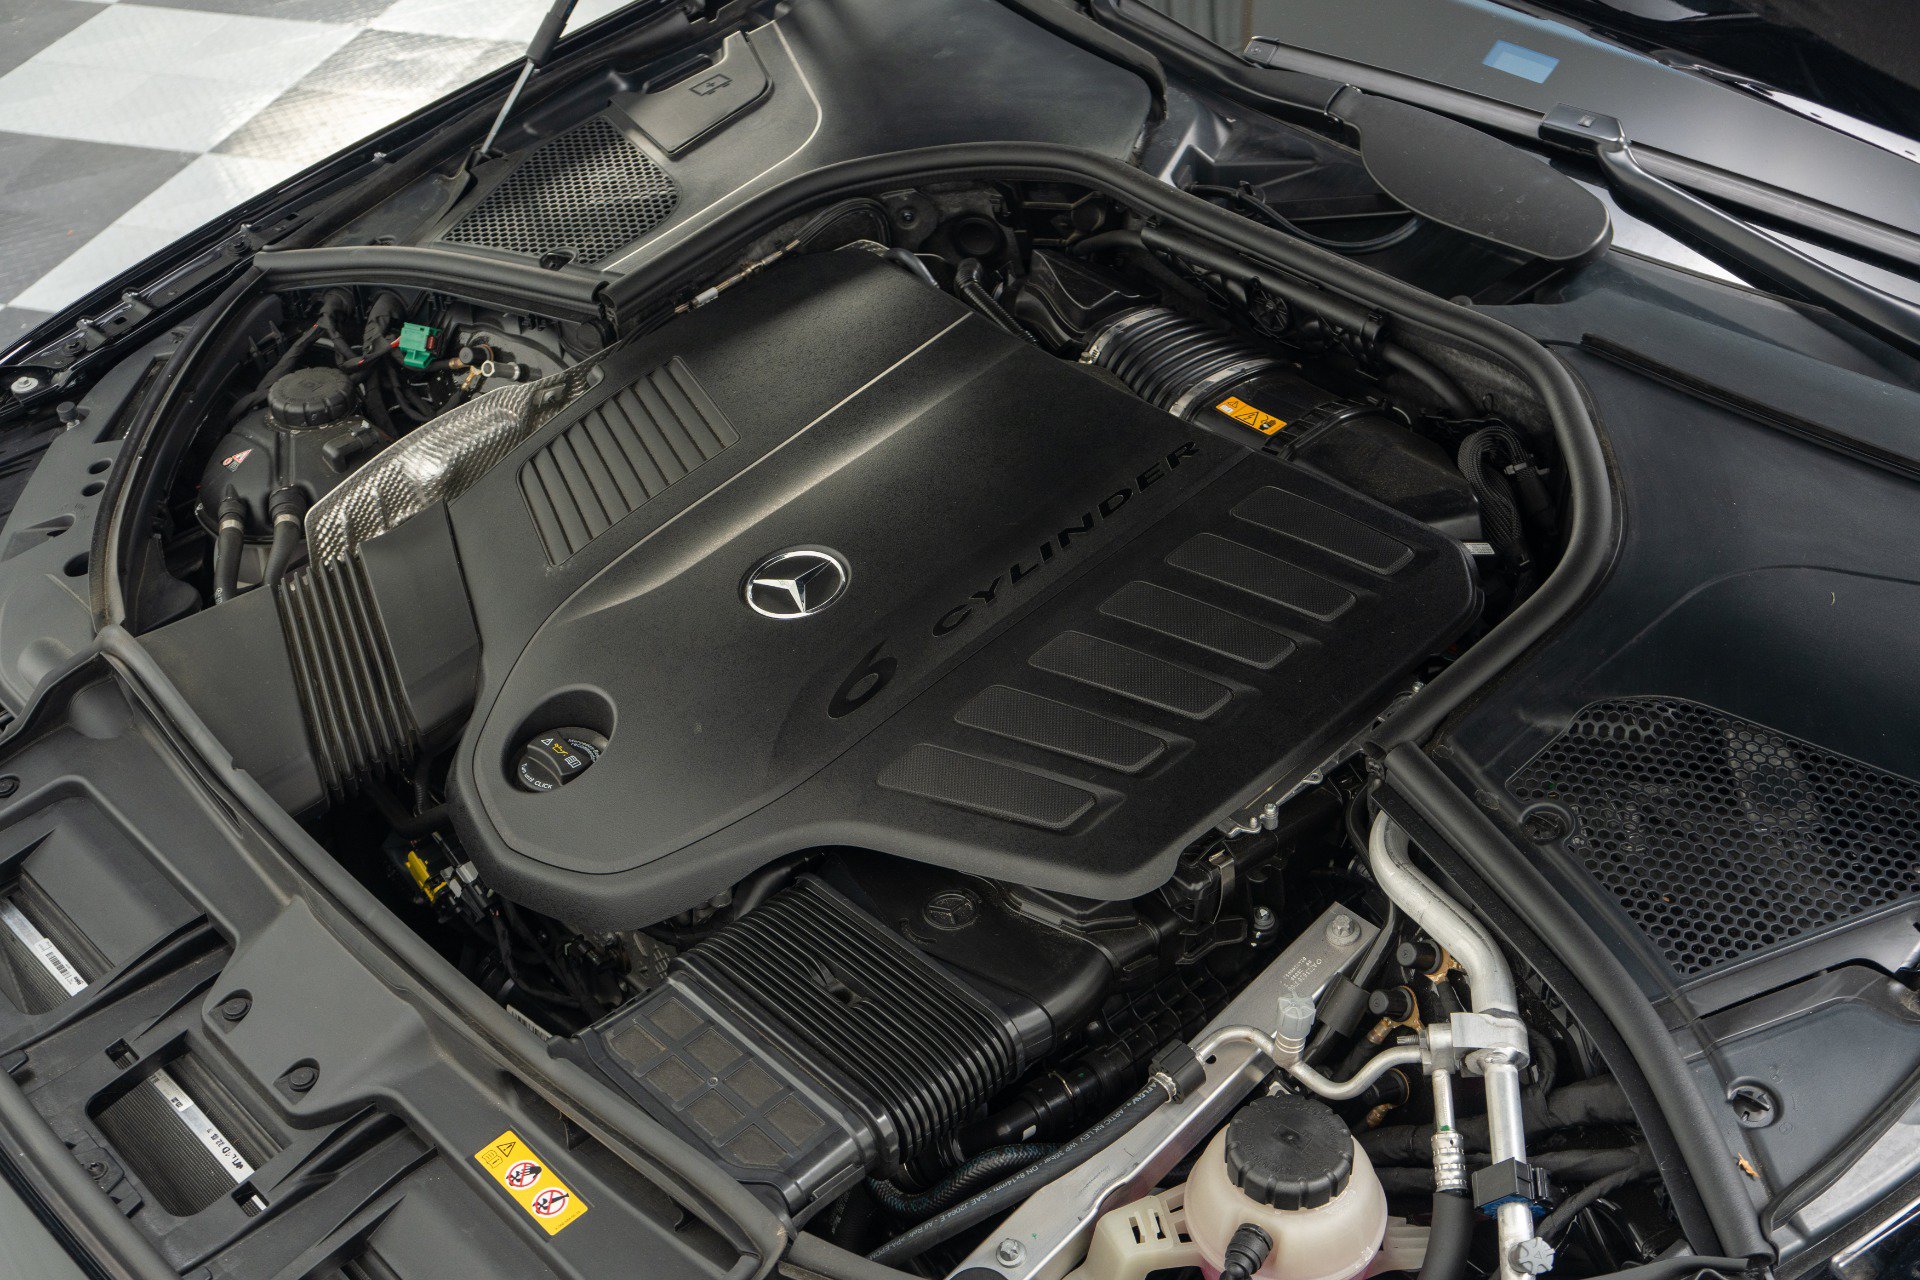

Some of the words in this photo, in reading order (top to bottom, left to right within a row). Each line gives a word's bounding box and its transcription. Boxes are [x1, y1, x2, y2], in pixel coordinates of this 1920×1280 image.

[827, 640, 898, 719] 6
[931, 440, 1198, 638] CYLINDER
[534, 780, 553, 789] CLICK
[1080, 1130, 1094, 1143] LEV
[1065, 1141, 1079, 1153] WP
[1026, 1165, 1039, 1176] DN
[993, 1173, 1026, 1192] 8x14mm
[970, 1193, 988, 1206] SAE
[940, 1202, 968, 1223] J2064-E
